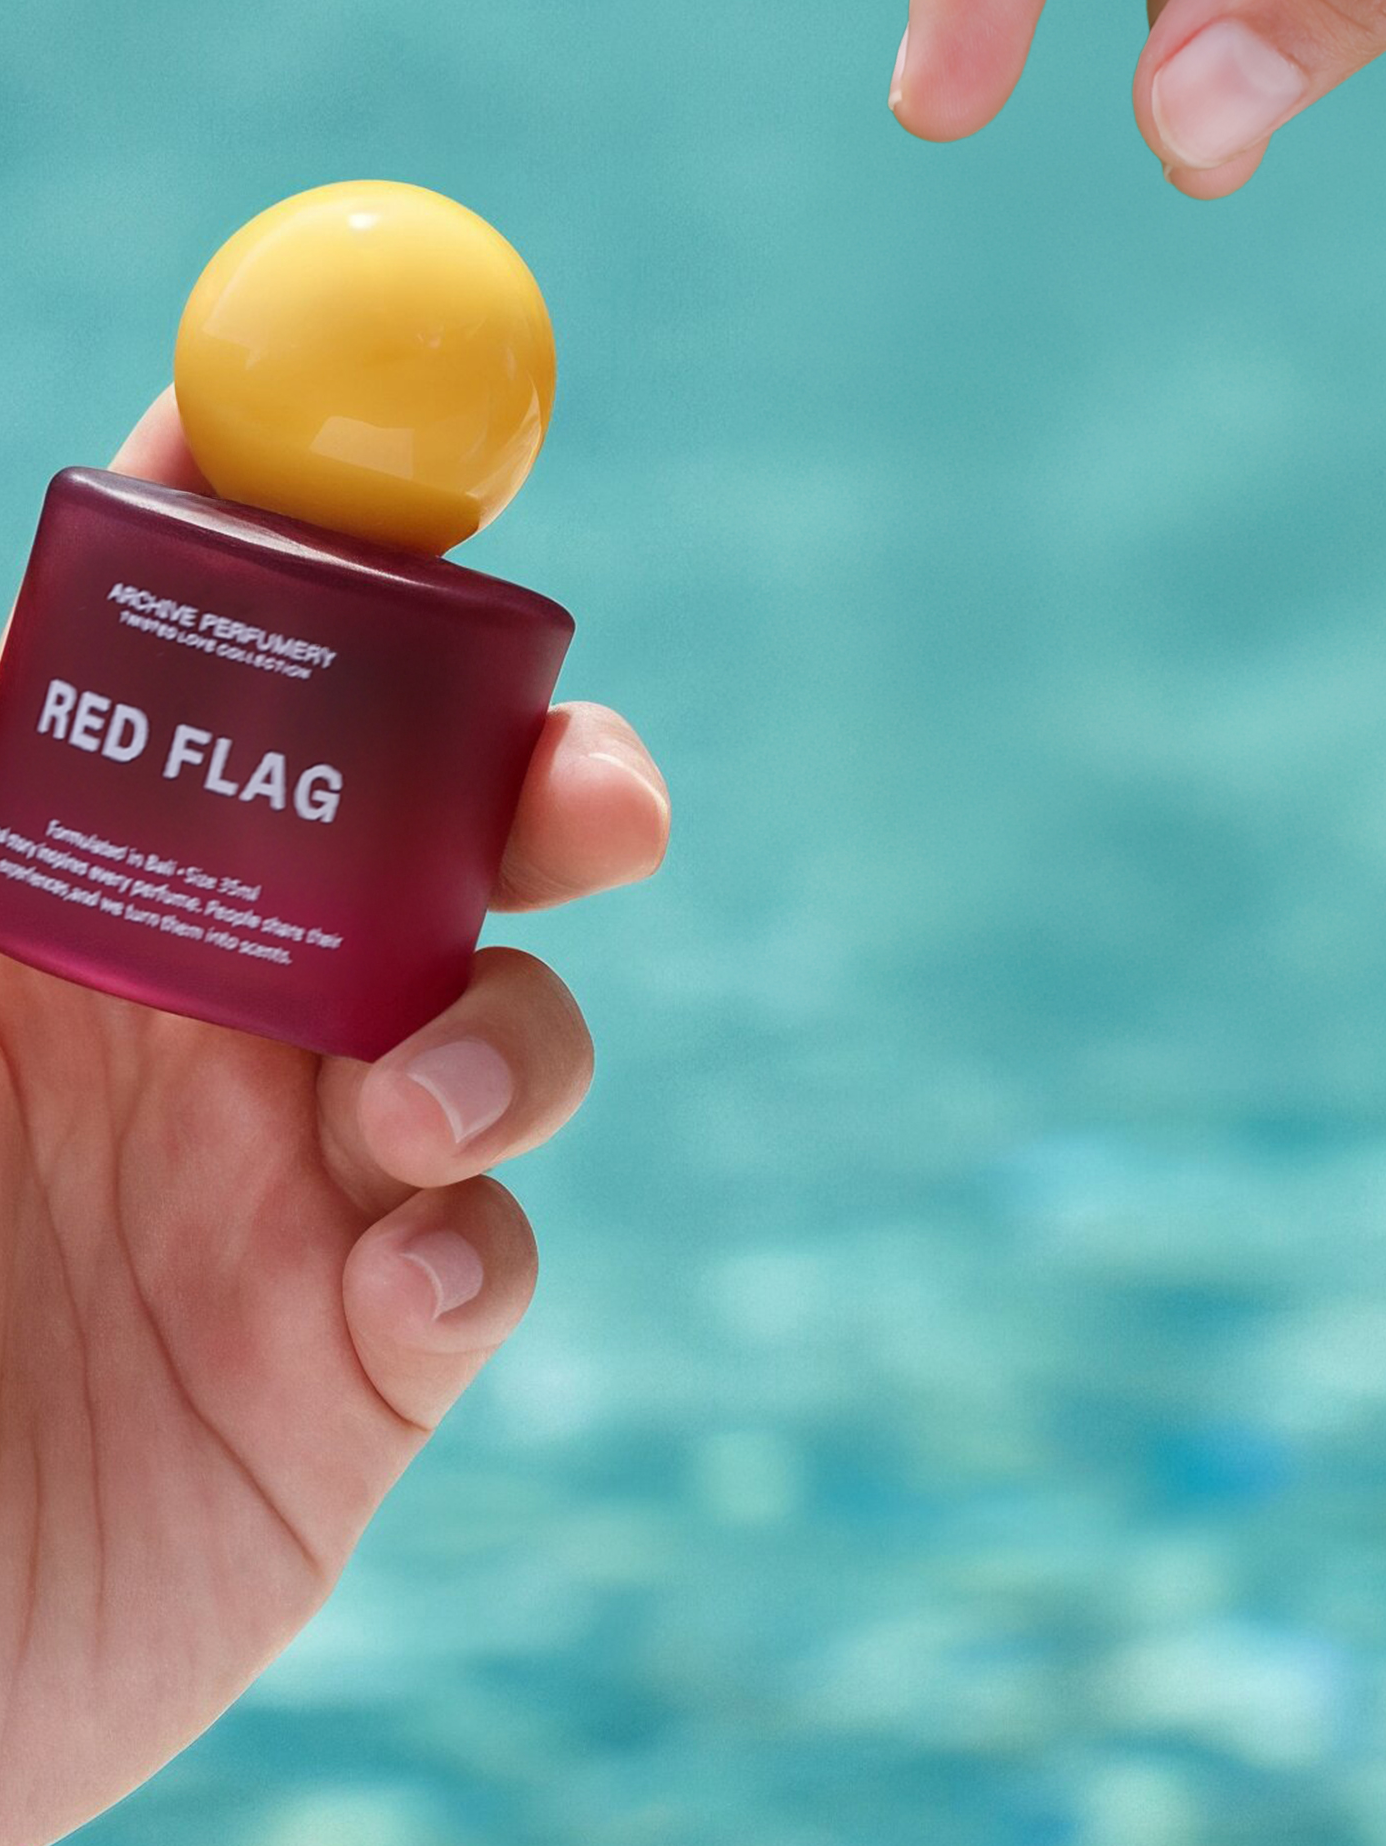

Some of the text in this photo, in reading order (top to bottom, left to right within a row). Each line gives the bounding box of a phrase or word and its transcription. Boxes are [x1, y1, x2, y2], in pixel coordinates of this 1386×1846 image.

[107, 583, 336, 668] ARCHIVE PERFUMERY
[178, 631, 217, 653] LOVE
[216, 643, 312, 680] COLLECTION
[37, 679, 343, 823] RED FLAG
[45, 819, 128, 861] Formulated
[126, 848, 144, 868] in
[204, 926, 240, 951] into
